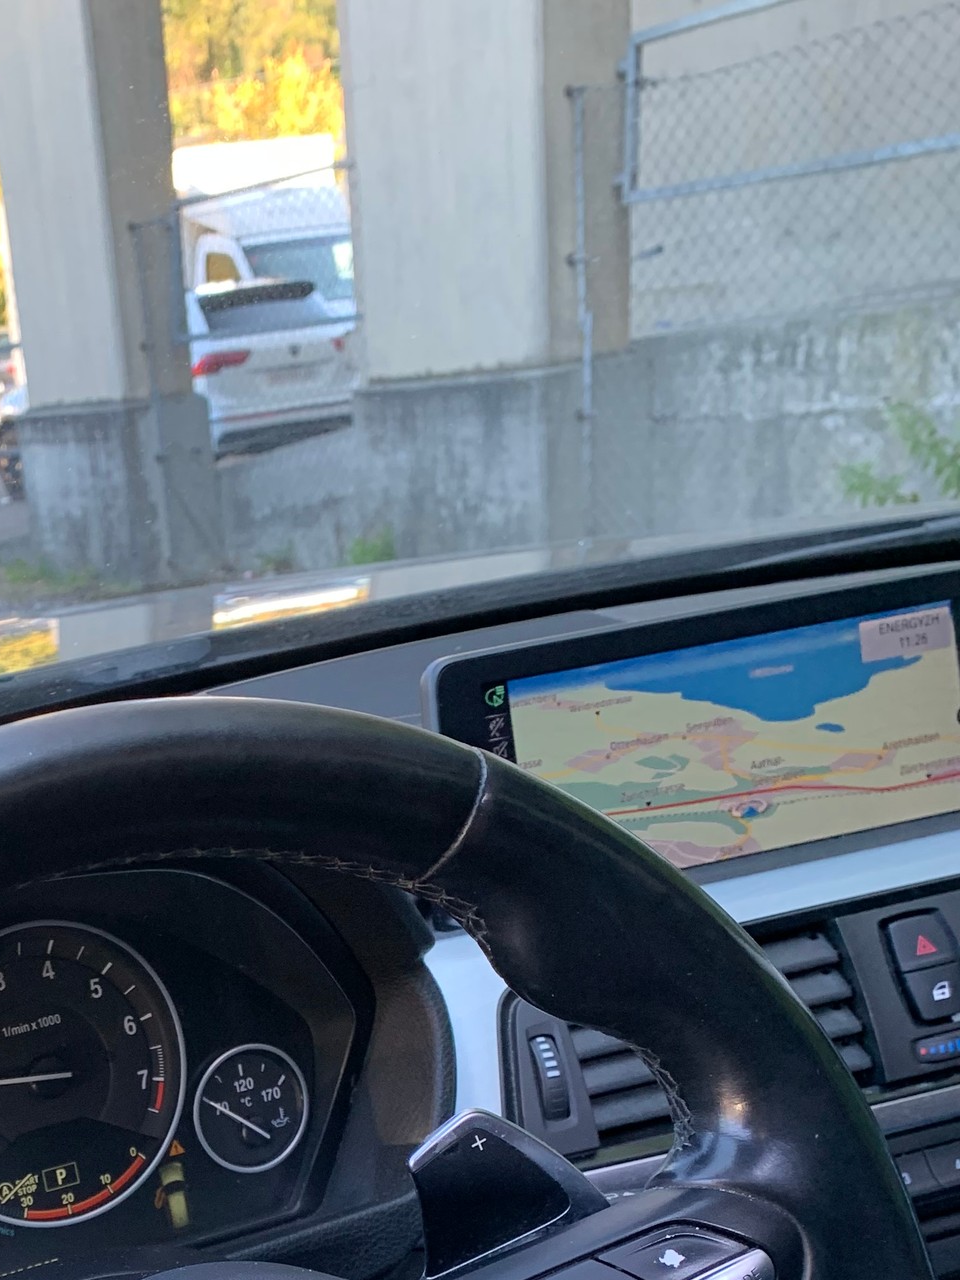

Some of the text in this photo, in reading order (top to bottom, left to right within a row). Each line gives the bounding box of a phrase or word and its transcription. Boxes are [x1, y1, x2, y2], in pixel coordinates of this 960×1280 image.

[42, 960, 55, 979] 4
[90, 977, 103, 999] 5
[1, 1020, 30, 1038] 1/min
[39, 1013, 62, 1029] 1000
[123, 1015, 137, 1035] 6
[137, 1069, 149, 1090] 7
[233, 1077, 254, 1093] 120
[261, 1086, 281, 1102] 170
[129, 1146, 137, 1157] 0
[55, 1168, 67, 1185] P
[99, 1173, 112, 1185] 10
[17, 1184, 38, 1197] STOP
[61, 1192, 75, 1204] 20
[20, 1195, 34, 1208] 30
